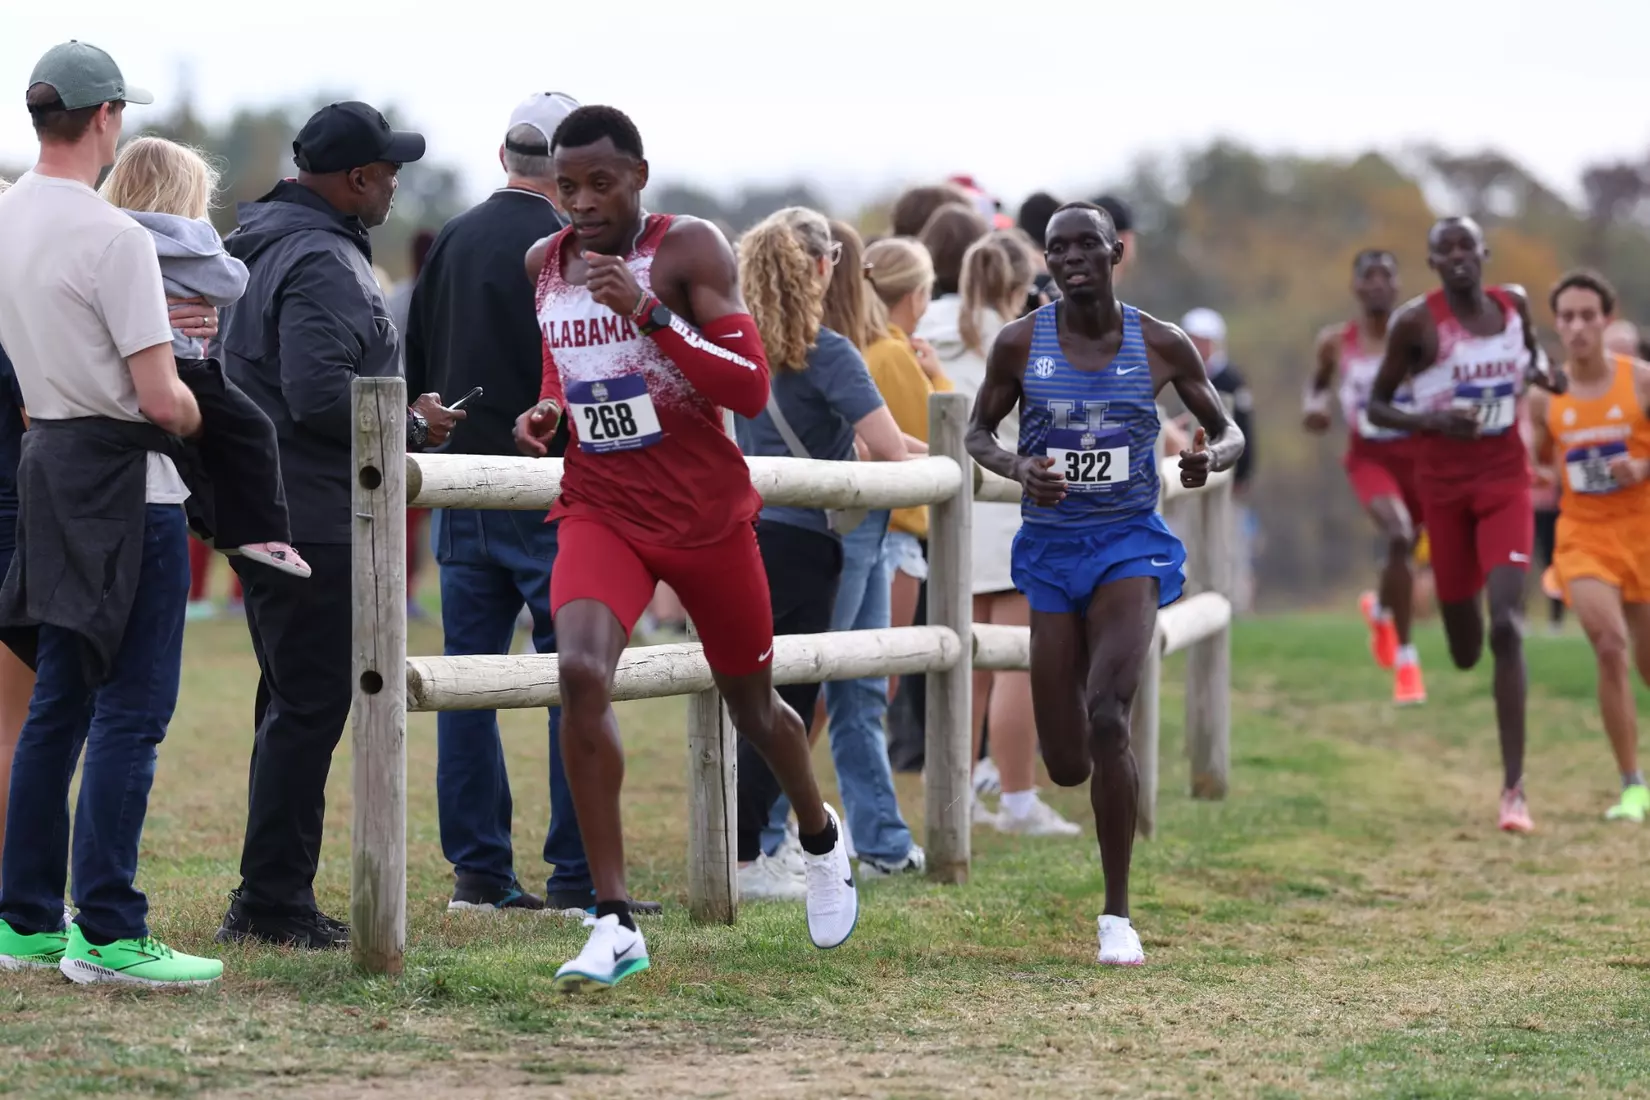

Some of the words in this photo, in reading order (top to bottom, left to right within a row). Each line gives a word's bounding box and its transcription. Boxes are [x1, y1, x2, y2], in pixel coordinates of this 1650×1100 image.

[542, 315, 637, 348] ALABAMA
[1035, 357, 1054, 377] SEC
[1452, 361, 1517, 382] ALABAM
[583, 402, 638, 440] 268
[1065, 451, 1112, 482] 322
